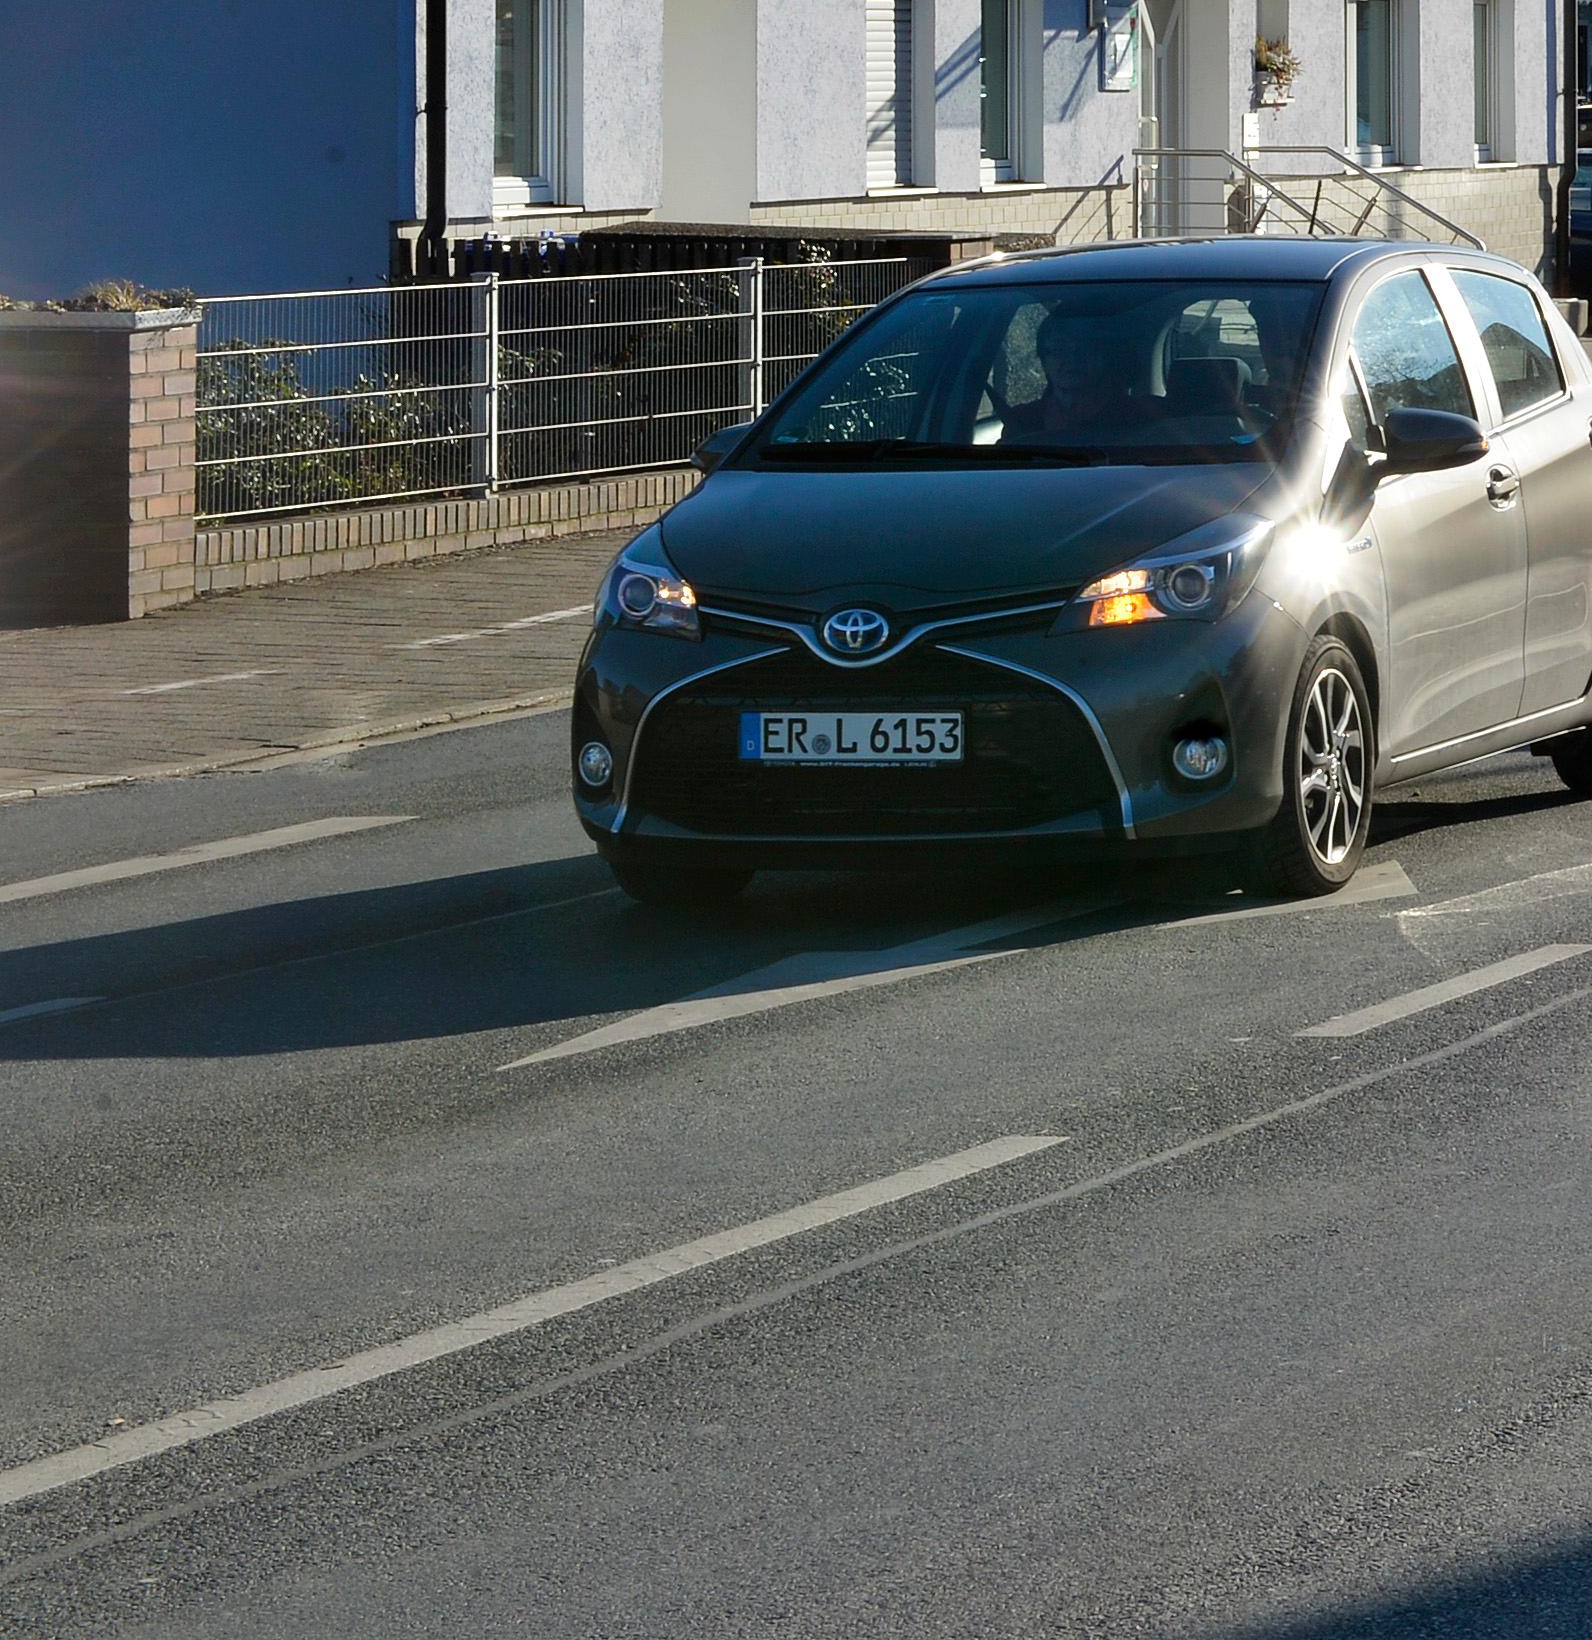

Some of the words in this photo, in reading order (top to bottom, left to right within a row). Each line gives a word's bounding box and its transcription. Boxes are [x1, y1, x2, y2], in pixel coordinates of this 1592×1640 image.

[763, 718, 808, 753] ER
[836, 718, 858, 753] L
[870, 718, 960, 754] 6153
